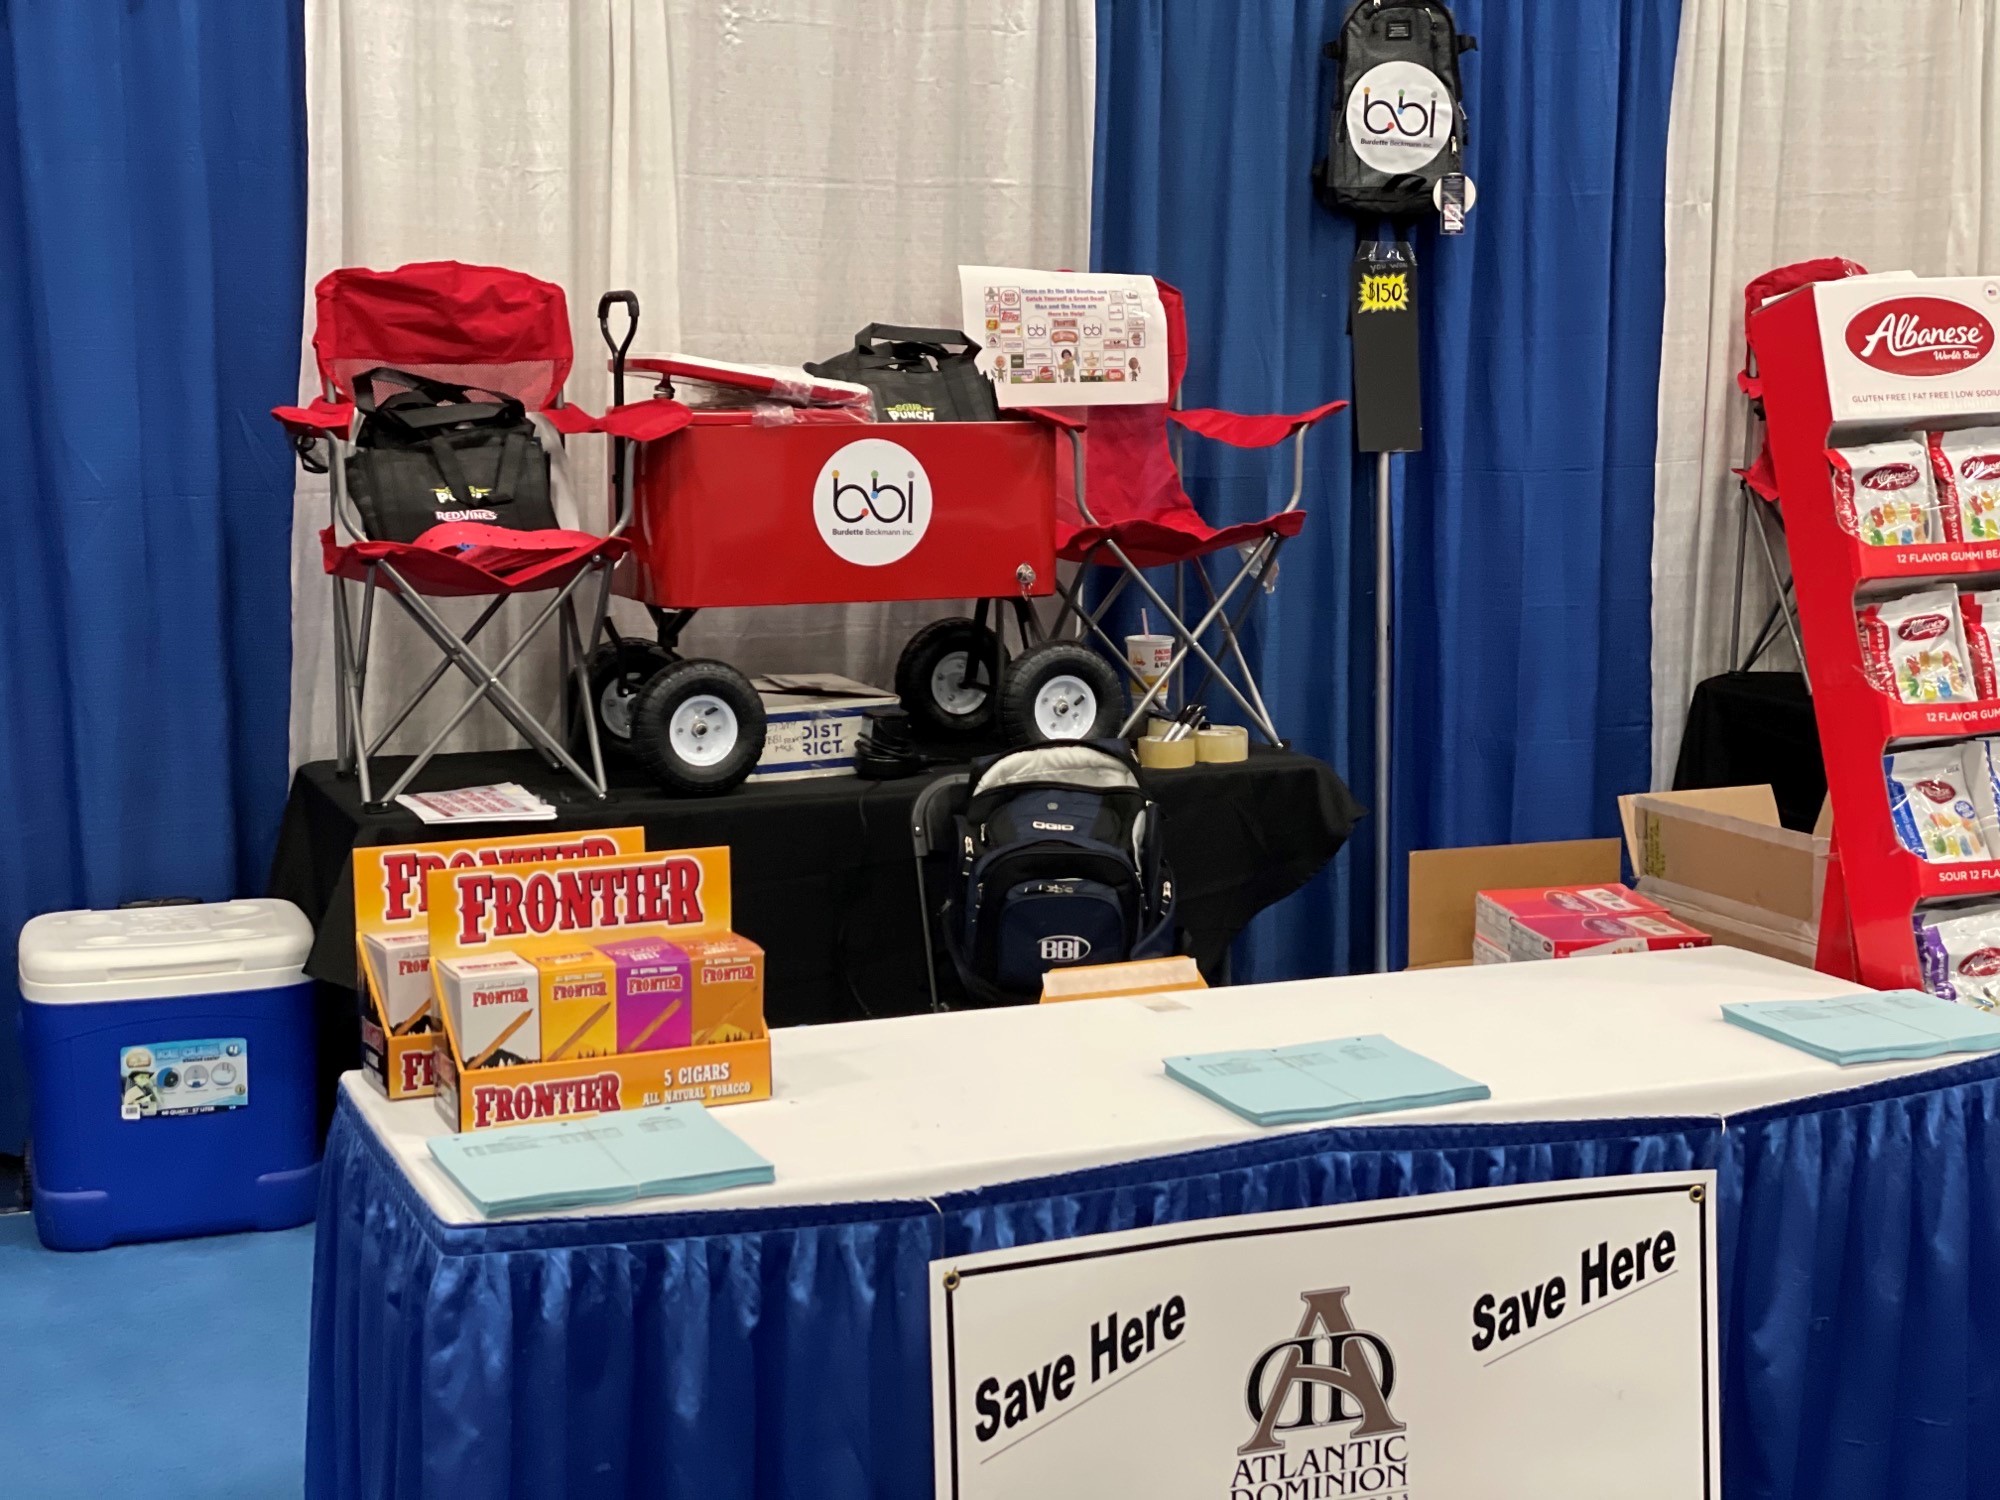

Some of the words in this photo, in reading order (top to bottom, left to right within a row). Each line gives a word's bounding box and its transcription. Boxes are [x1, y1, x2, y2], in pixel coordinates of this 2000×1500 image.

[1366, 281, 1402, 302] $150
[1860, 313, 1983, 357] Albanese
[1852, 393, 1884, 403] GLUTEN
[1885, 392, 1907, 401] FREE
[1912, 392, 1927, 400] FAT
[1929, 391, 1949, 399] FREE
[1955, 391, 1973, 399] LOW
[888, 410, 935, 421] PUNCH
[895, 403, 923, 411] SOUR
[832, 528, 863, 536] Burdette
[865, 528, 900, 536] Beckmann
[1897, 554, 1906, 563] 12
[1909, 551, 1949, 562] FLAVOR
[1951, 551, 1984, 561] GUMMI
[1986, 549, 2000, 559] BE
[1926, 713, 1936, 722] 12
[1939, 711, 1978, 721] FLAVOR
[803, 723, 842, 739] DIST
[1033, 821, 1074, 831] OGIO
[1939, 872, 1967, 881] SOUR
[1969, 870, 1979, 879] 12
[458, 858, 703, 944] FRONTIER
[1041, 940, 1080, 960] BBI
[703, 965, 755, 983] FRONTIER
[553, 982, 607, 1000] FRONTIER
[628, 976, 682, 994] FRONTIER
[473, 988, 528, 1007] FRONTIER
[664, 1069, 672, 1086] 5
[678, 1062, 730, 1084] CIGARS
[475, 1073, 621, 1127] FRONTIER
[642, 1093, 660, 1106] ALL
[664, 1088, 706, 1103] NATURAL
[710, 1082, 751, 1098] TOBACCO
[1472, 1276, 1566, 1351] Save
[1581, 1230, 1676, 1305] Here
[975, 1354, 1075, 1442] Save
[1090, 1295, 1186, 1383] Here
[1230, 1435, 1409, 1488] ATLANTIC
